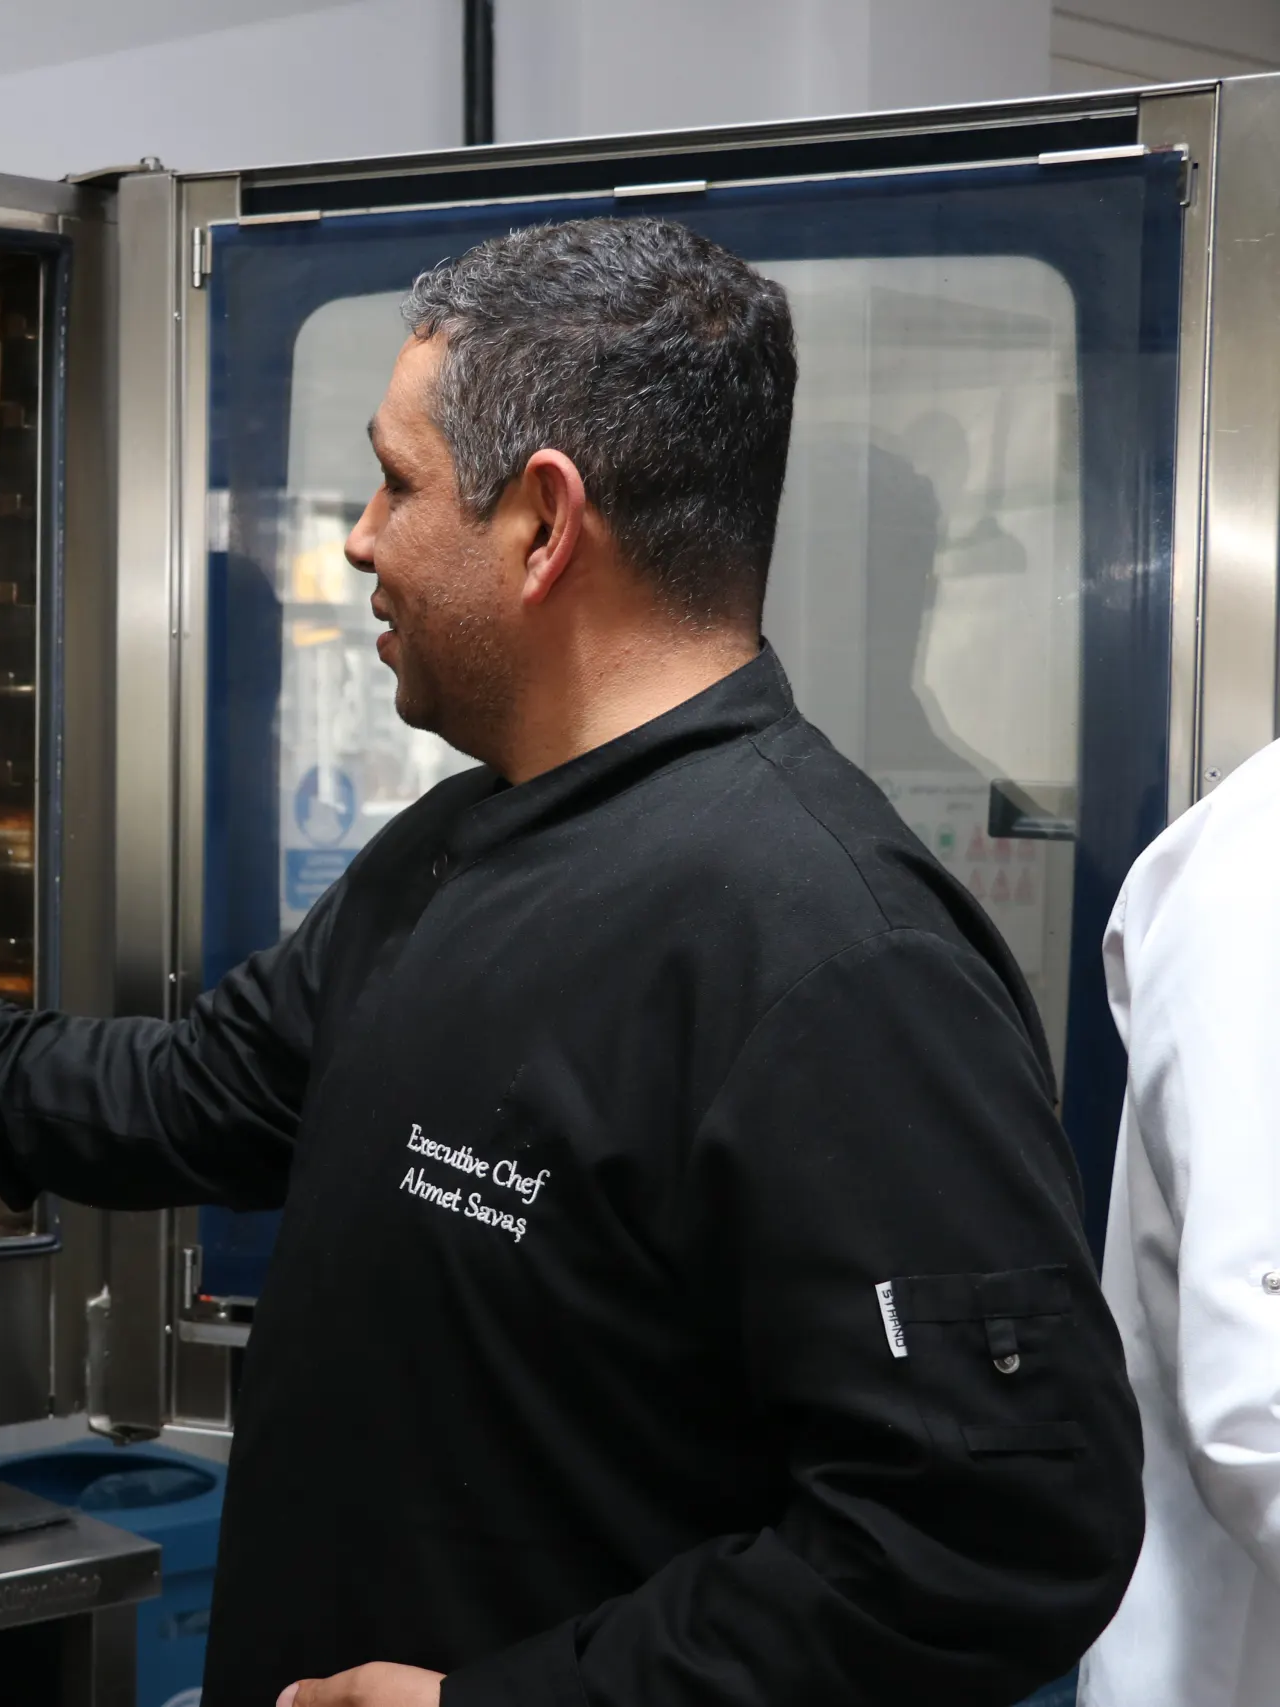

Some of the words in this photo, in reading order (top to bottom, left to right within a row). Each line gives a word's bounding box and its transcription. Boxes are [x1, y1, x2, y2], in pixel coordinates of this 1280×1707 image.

[407, 1124, 489, 1178] Executive
[492, 1160, 551, 1205] Chef
[399, 1167, 462, 1212] Ahmet
[464, 1193, 527, 1243] Savaş
